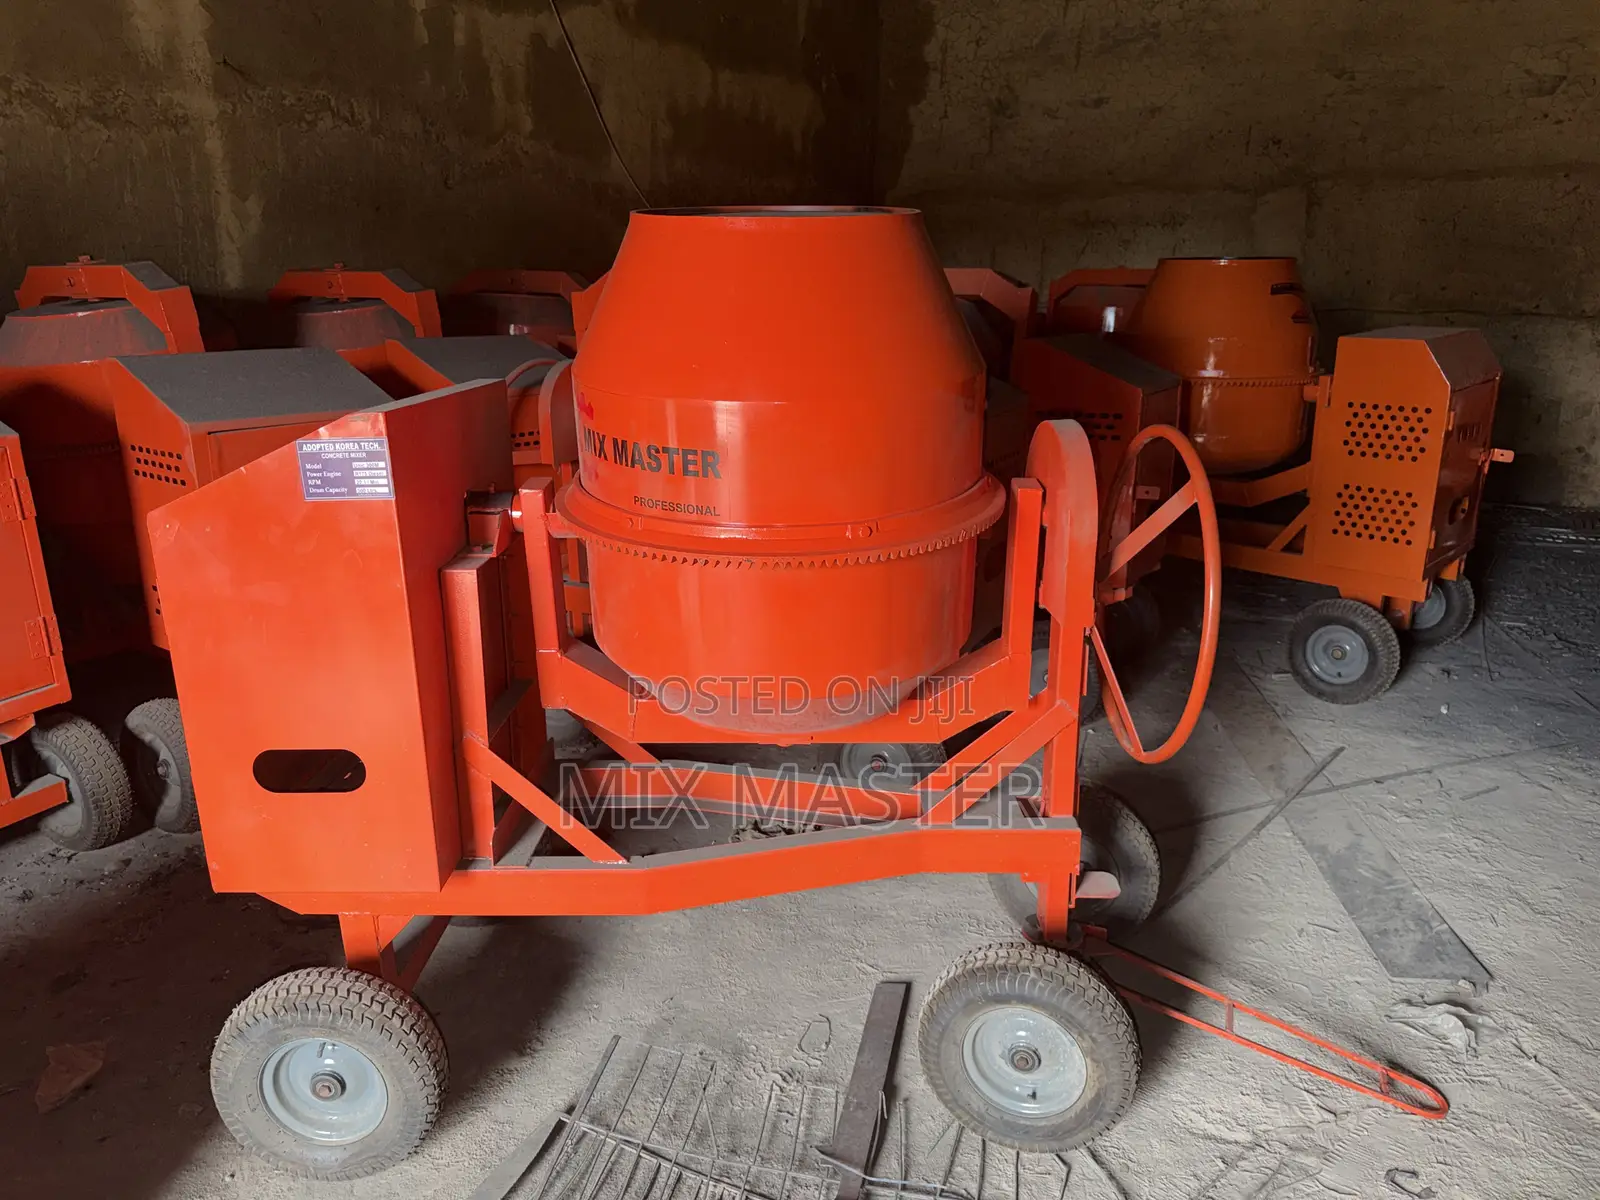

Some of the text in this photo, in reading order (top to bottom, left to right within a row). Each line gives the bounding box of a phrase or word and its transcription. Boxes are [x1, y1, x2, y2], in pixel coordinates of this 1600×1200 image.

[302, 443, 334, 451] ADOPTED
[335, 442, 359, 450] KOREA
[583, 426, 722, 479] MIX MASTER
[325, 487, 348, 495] Capacity
[633, 496, 720, 517] PROFESSIONAL
